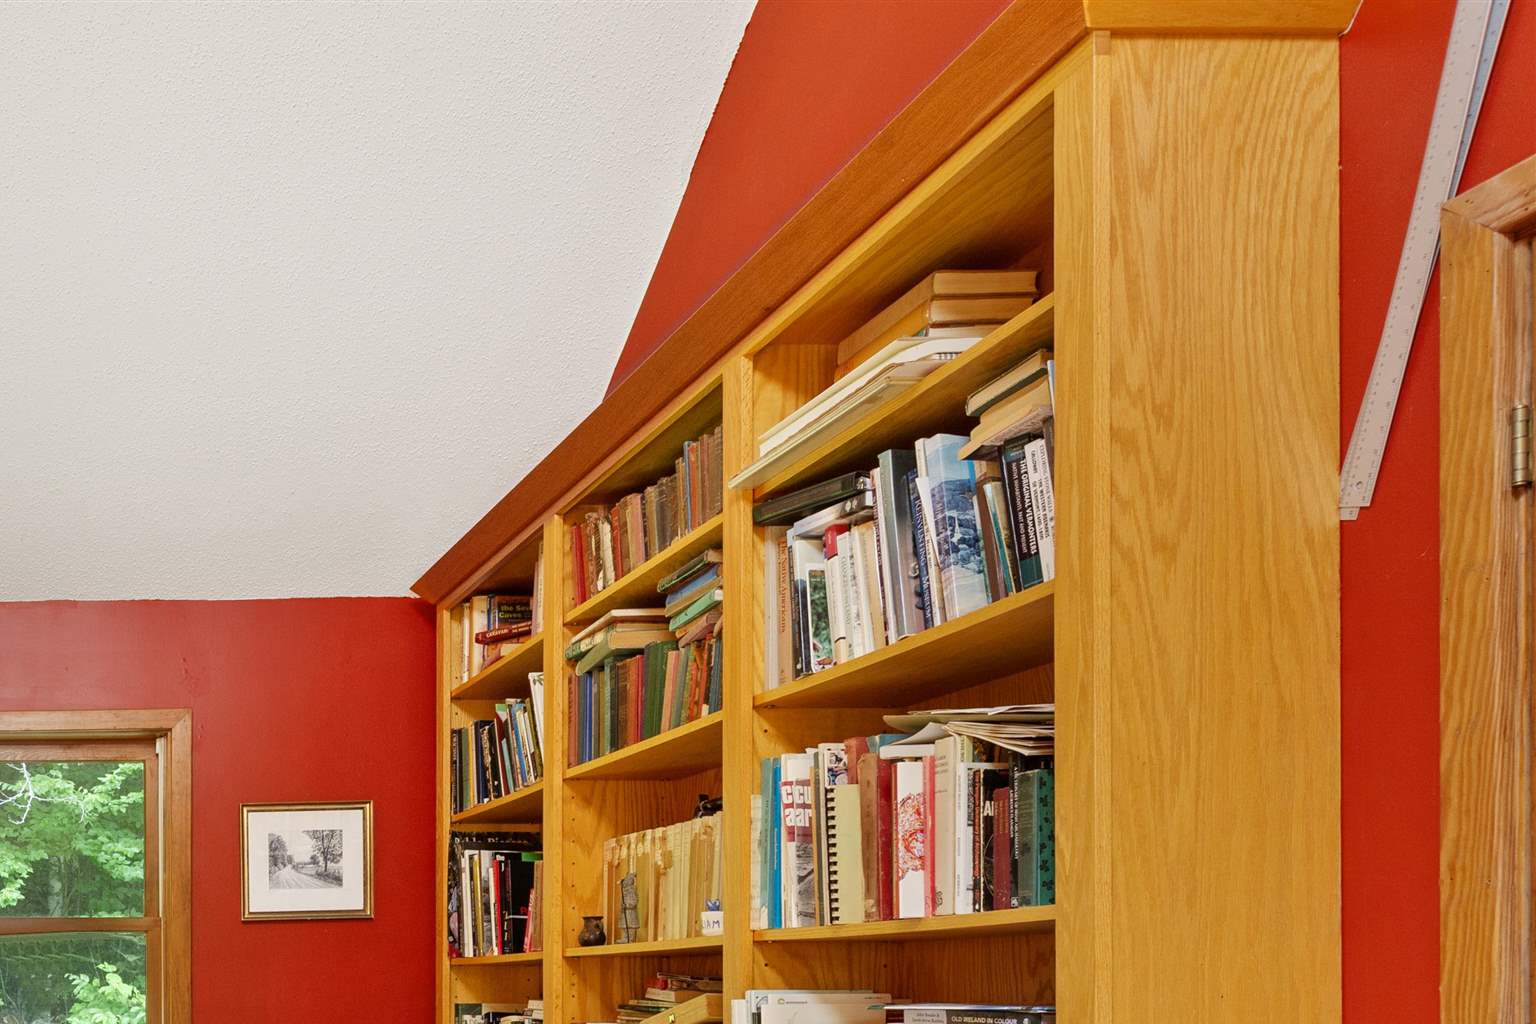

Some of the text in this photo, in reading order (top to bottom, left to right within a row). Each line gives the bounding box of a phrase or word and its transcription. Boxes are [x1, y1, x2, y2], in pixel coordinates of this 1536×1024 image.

[915, 500, 926, 566] REINVENTING
[921, 576, 932, 618] MUSEUM
[1020, 459, 1037, 554] THE ORIGINAL VERMONTERS
